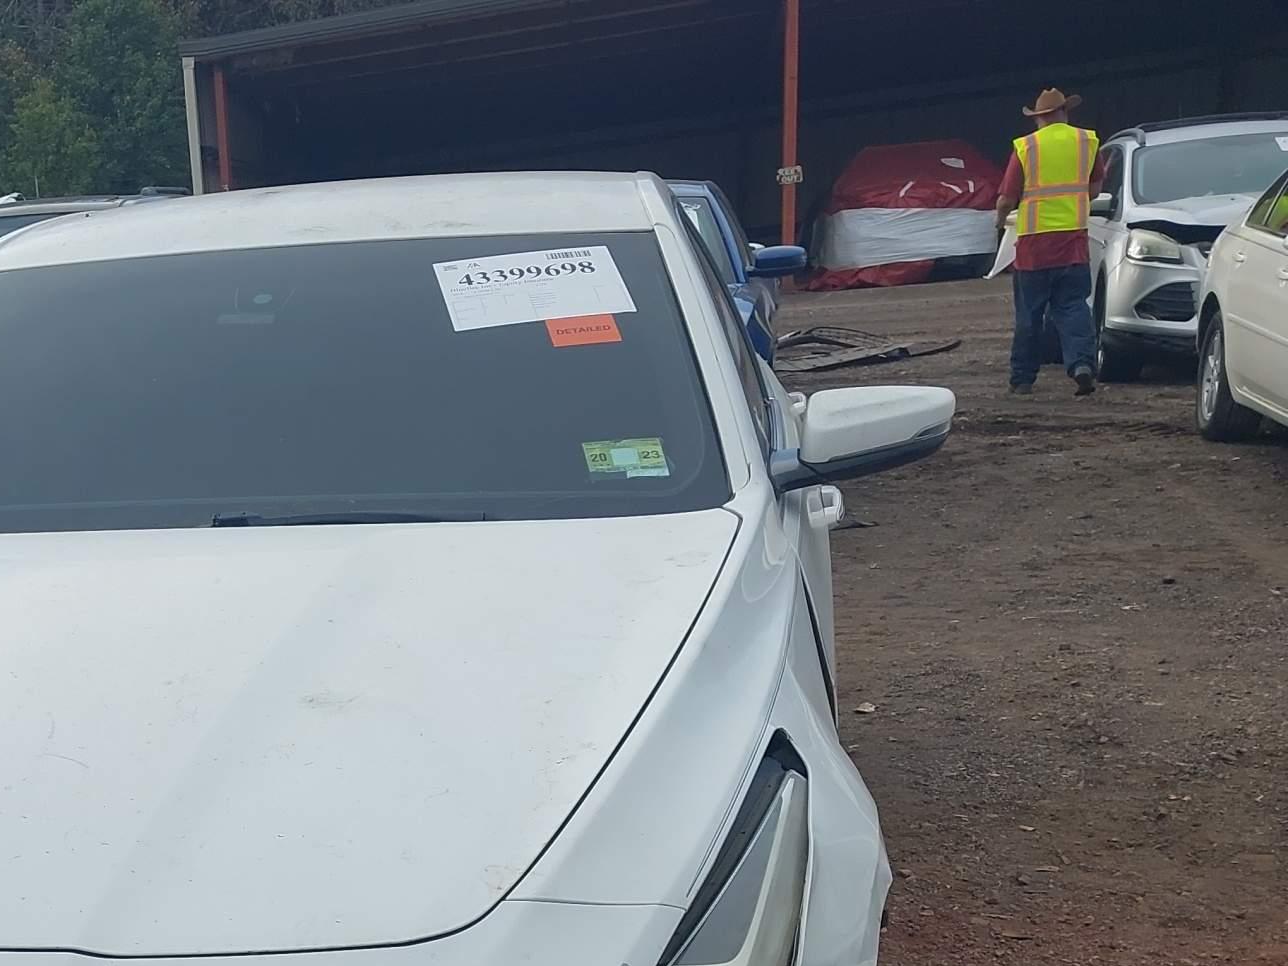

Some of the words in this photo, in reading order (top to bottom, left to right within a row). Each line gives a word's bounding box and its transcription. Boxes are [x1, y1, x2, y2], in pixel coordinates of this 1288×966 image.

[458, 260, 597, 286] 43399698
[556, 325, 611, 336] DETAILED
[590, 453, 608, 463] 20
[641, 450, 661, 459] 23
